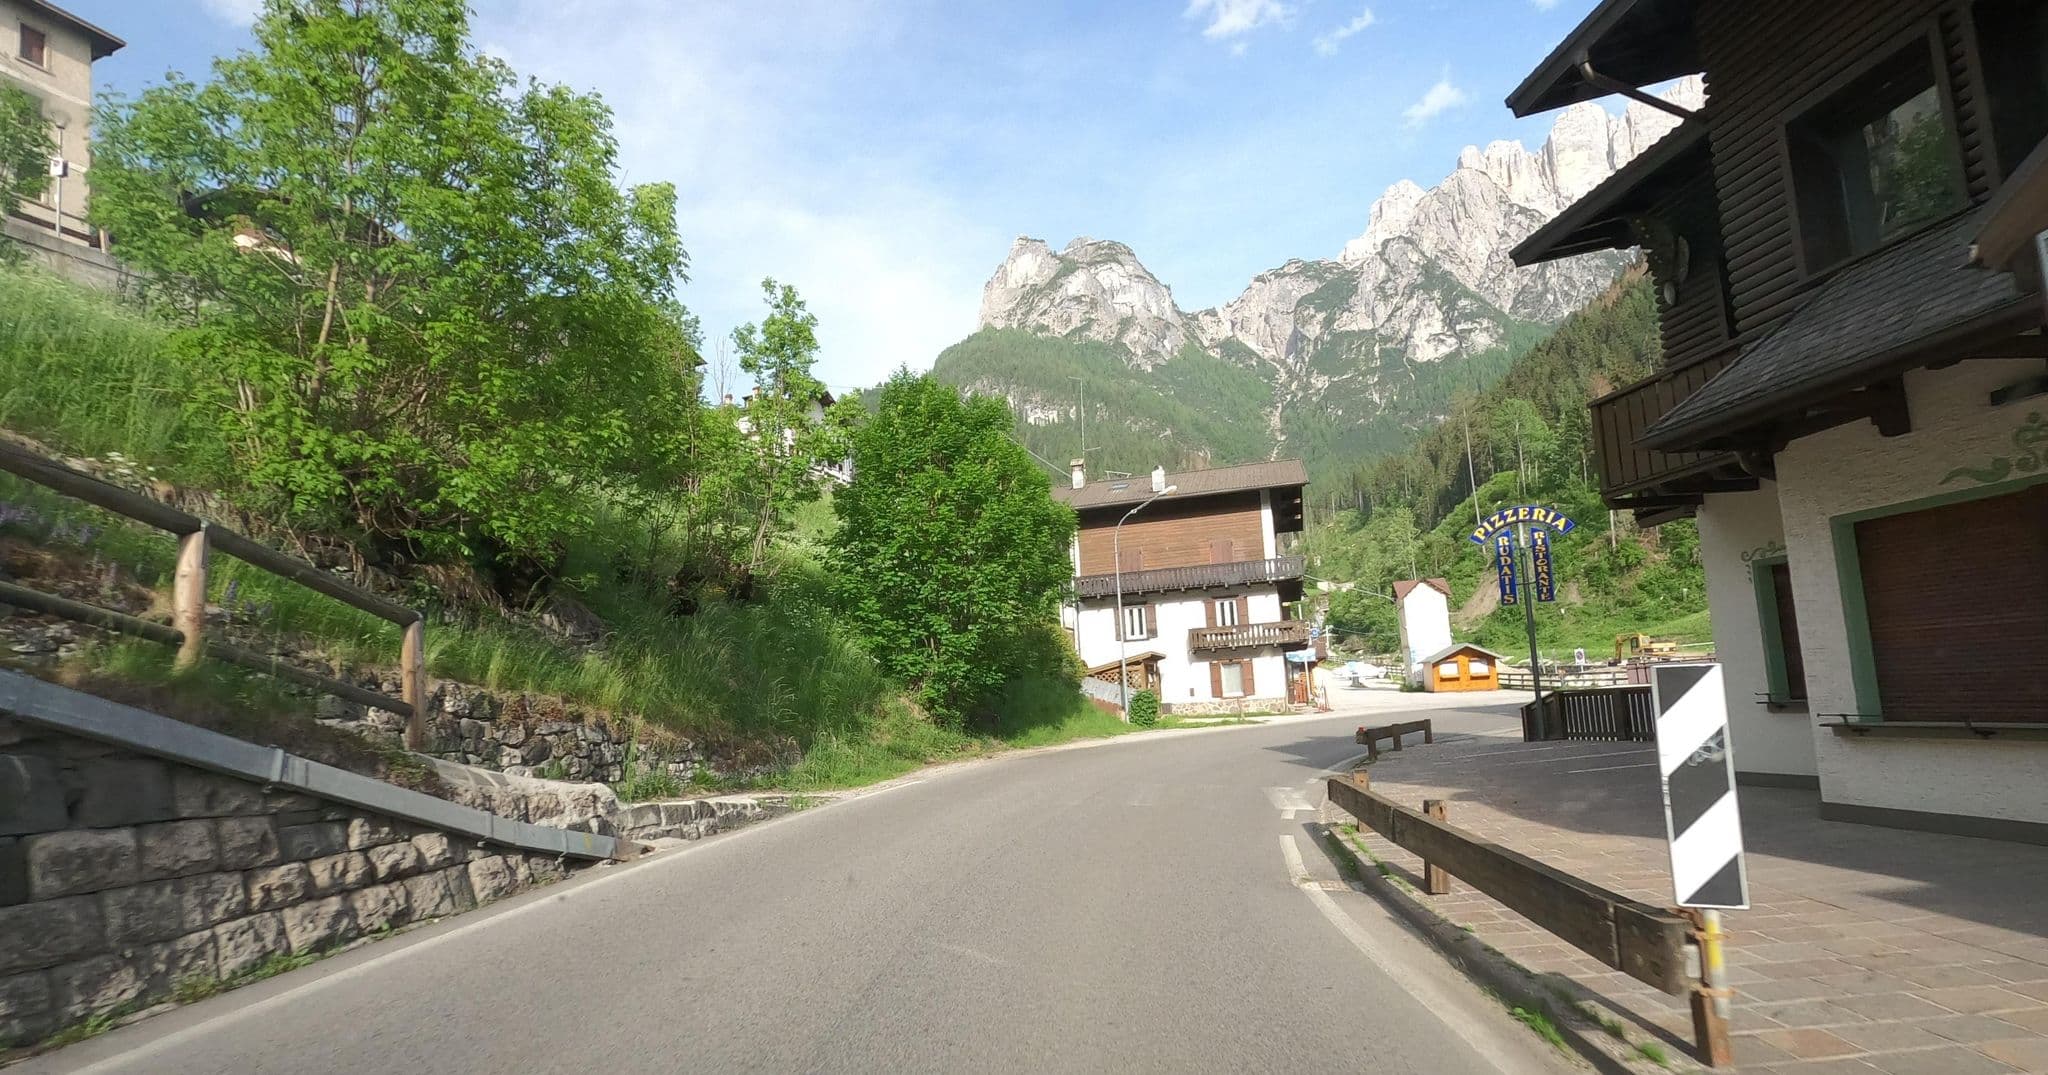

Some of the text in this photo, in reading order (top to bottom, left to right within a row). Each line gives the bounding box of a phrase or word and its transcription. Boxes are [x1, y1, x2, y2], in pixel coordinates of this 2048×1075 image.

[1474, 507, 1569, 540] PIZZERIA
[1498, 536, 1515, 604] RUDATIS
[1533, 531, 1551, 601] RISTORANTE
